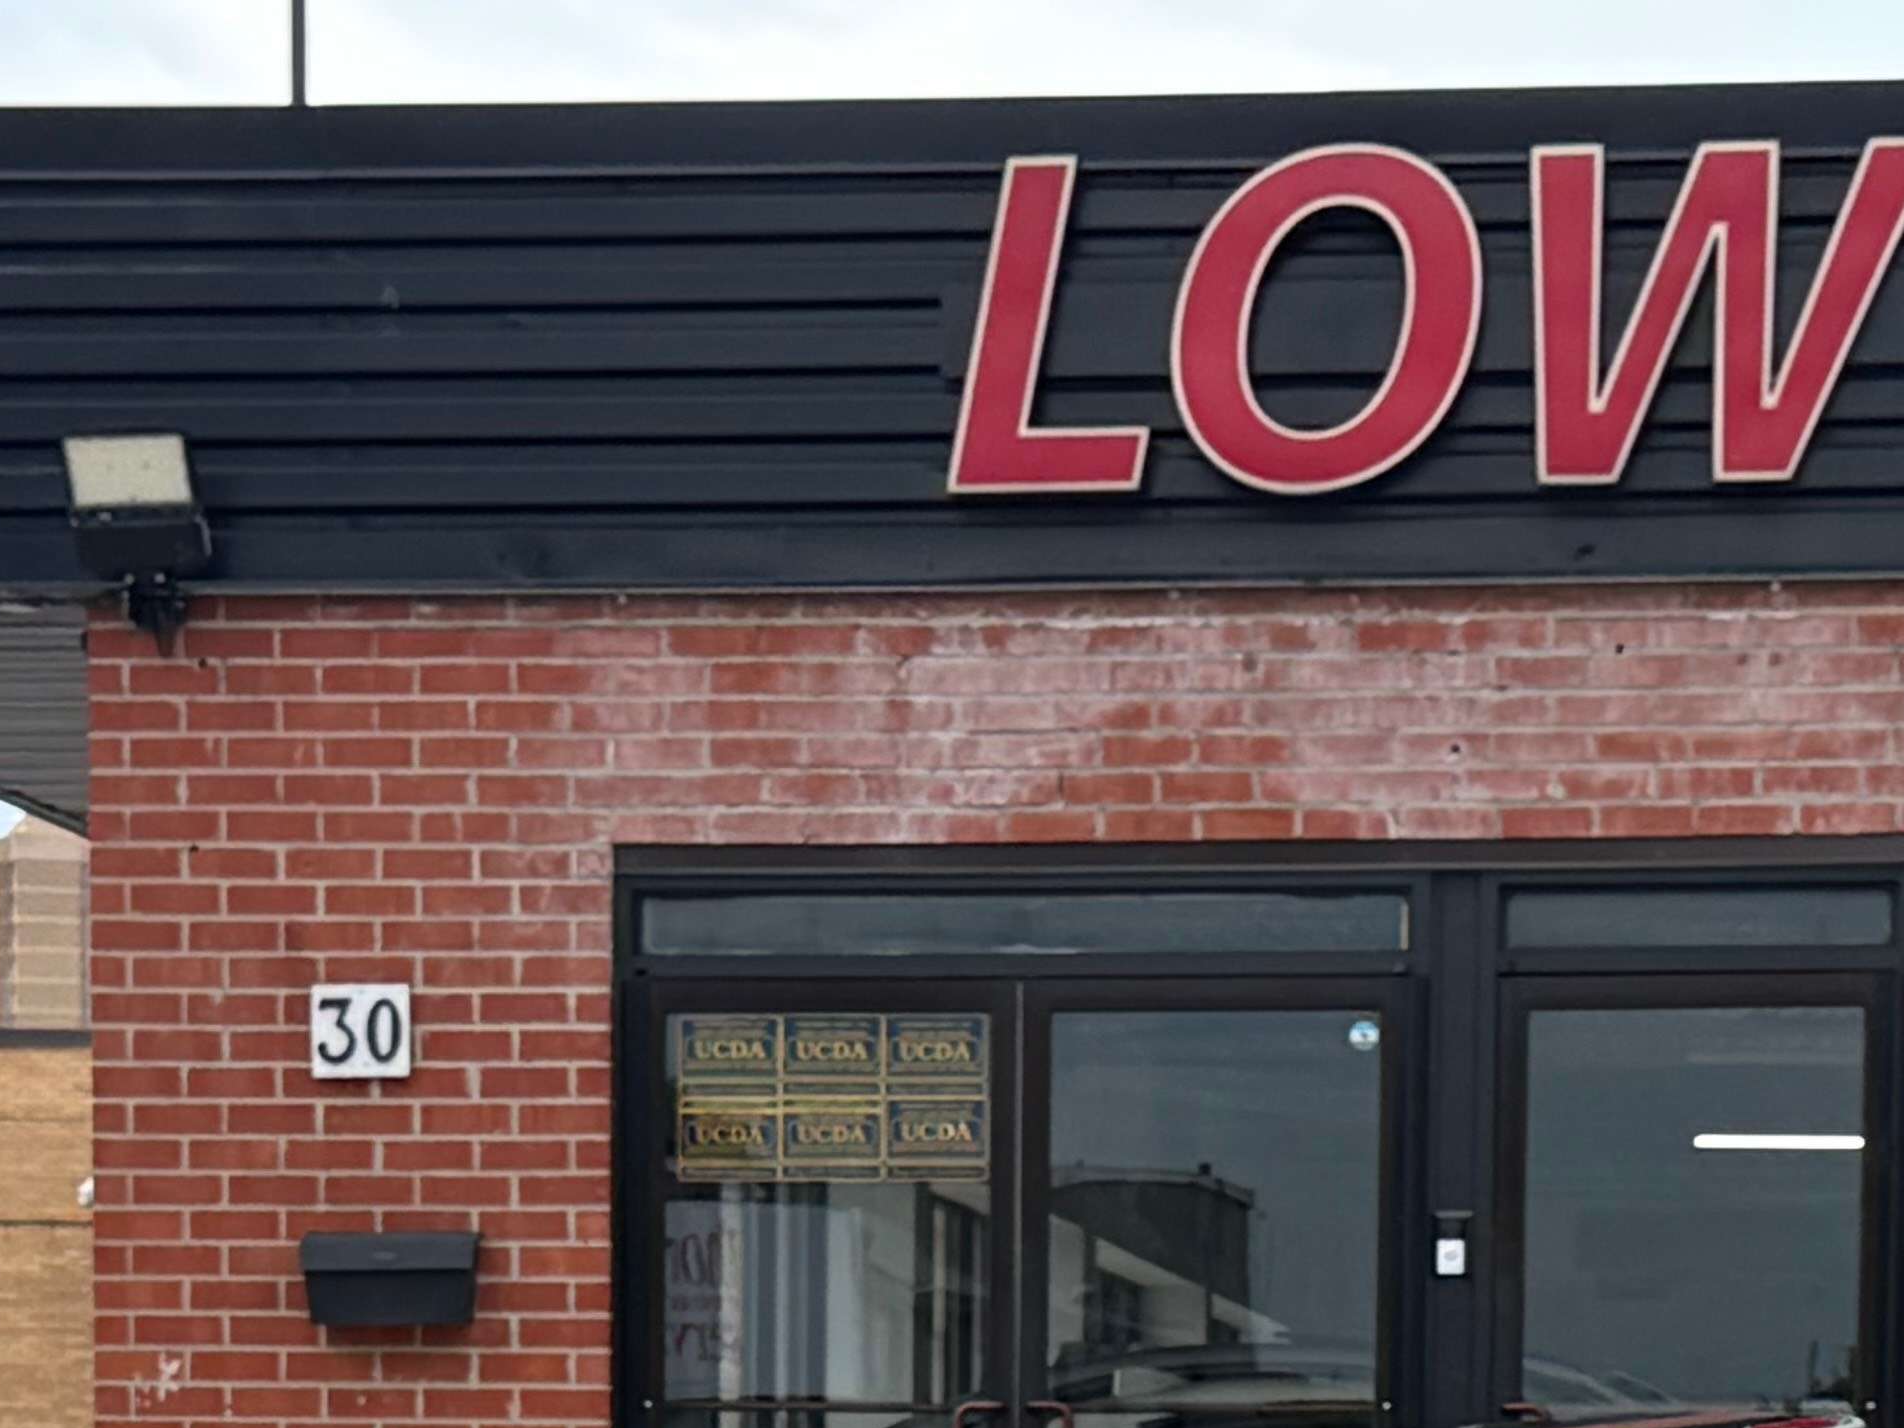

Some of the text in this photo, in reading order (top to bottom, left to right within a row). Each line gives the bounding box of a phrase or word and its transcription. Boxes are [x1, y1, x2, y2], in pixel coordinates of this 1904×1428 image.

[317, 998, 402, 1066] 30
[695, 1039, 767, 1060] UCDA
[796, 1039, 869, 1061] UCDA
[898, 1040, 971, 1062] UCDA
[696, 1123, 765, 1146] UCDA
[796, 1122, 867, 1144] UCDA
[899, 1120, 973, 1142] UCDA
